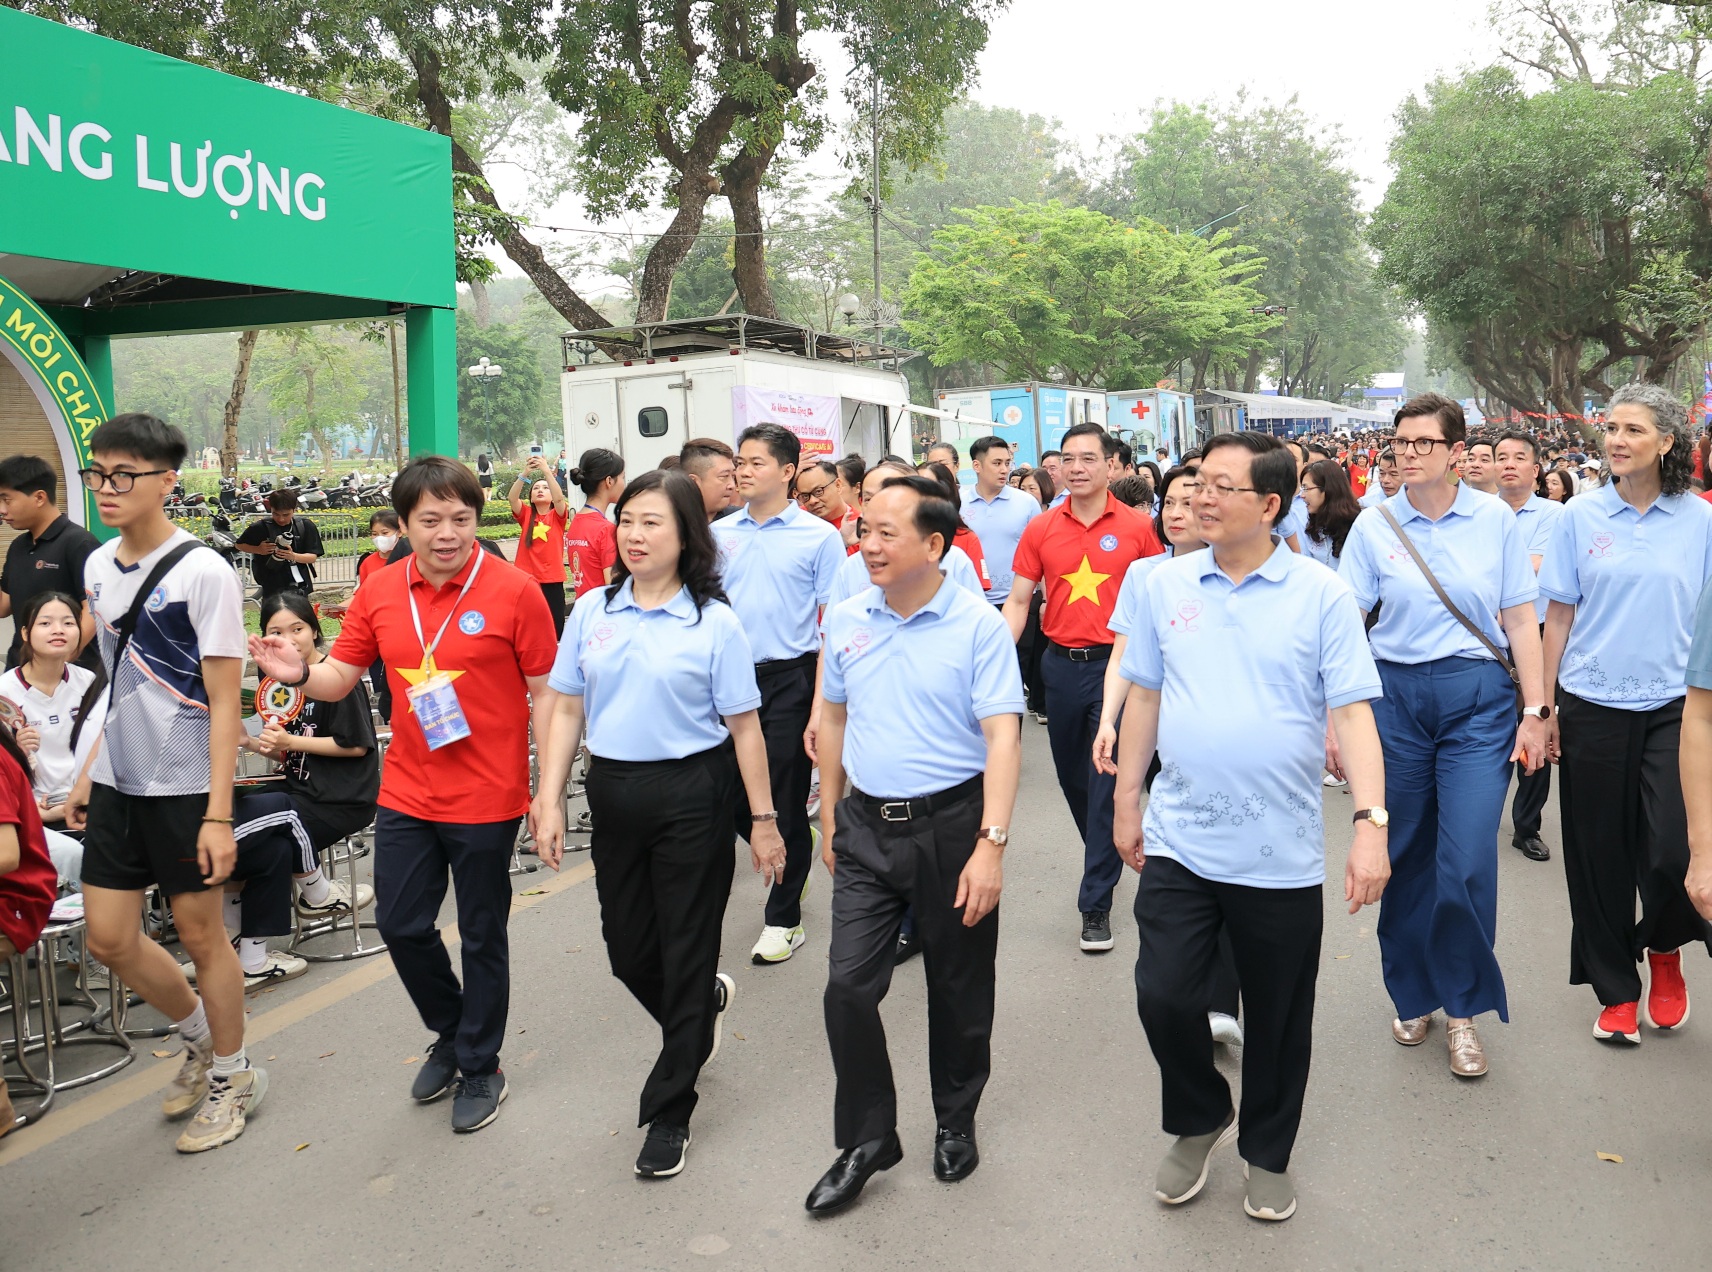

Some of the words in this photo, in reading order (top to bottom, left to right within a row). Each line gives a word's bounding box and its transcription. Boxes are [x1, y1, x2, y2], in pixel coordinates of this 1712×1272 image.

[136, 134, 327, 221] LƯỢNG
[5, 307, 62, 370] MỎI
[424, 721, 437, 730] BAN
